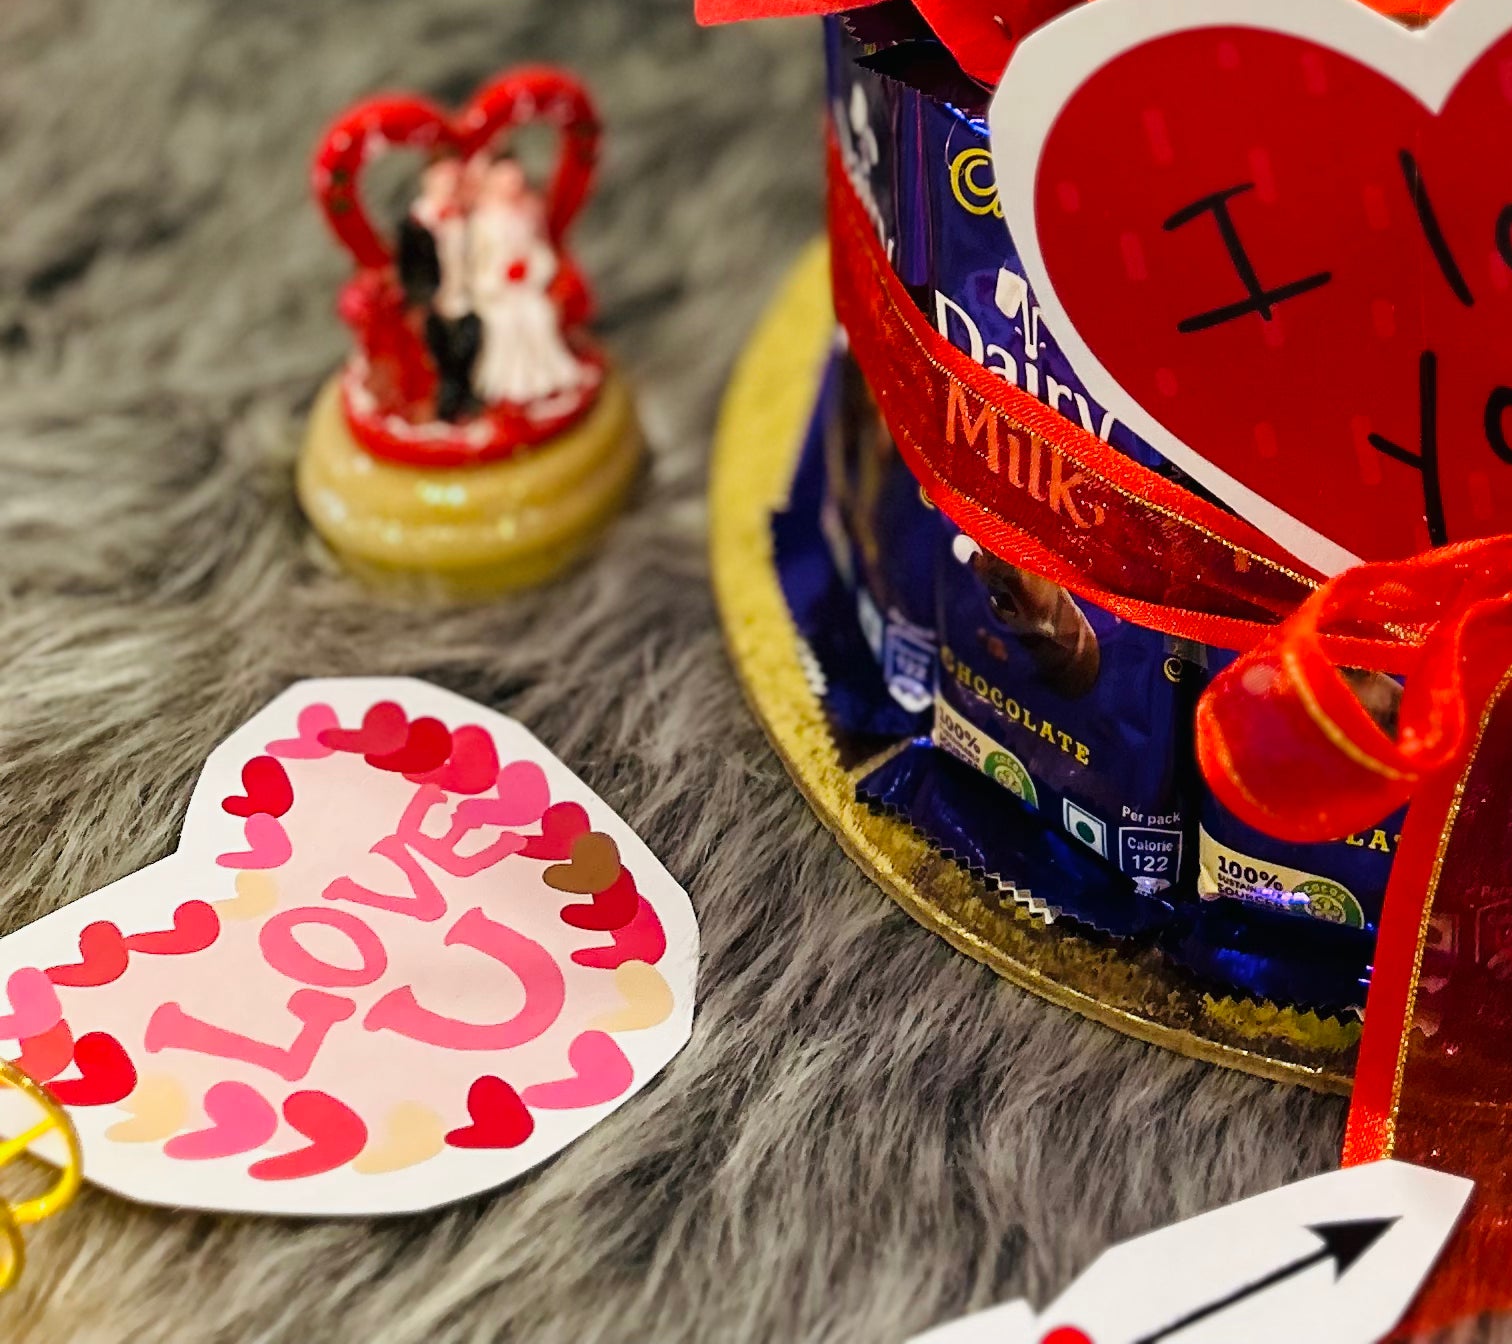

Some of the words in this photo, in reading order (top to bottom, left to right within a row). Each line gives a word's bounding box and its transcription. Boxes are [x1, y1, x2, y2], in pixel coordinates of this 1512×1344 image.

[1162, 180, 1333, 336] I
[940, 643, 1092, 766] CHOCOLATE
[1122, 805, 1143, 824] Per
[1147, 812, 1181, 827] pack
[1126, 836, 1174, 853] Calorie
[1131, 854, 1169, 873] 122
[1217, 855, 1284, 895] 100%
[143, 783, 530, 1082] LOVE
[362, 905, 567, 1051] U
